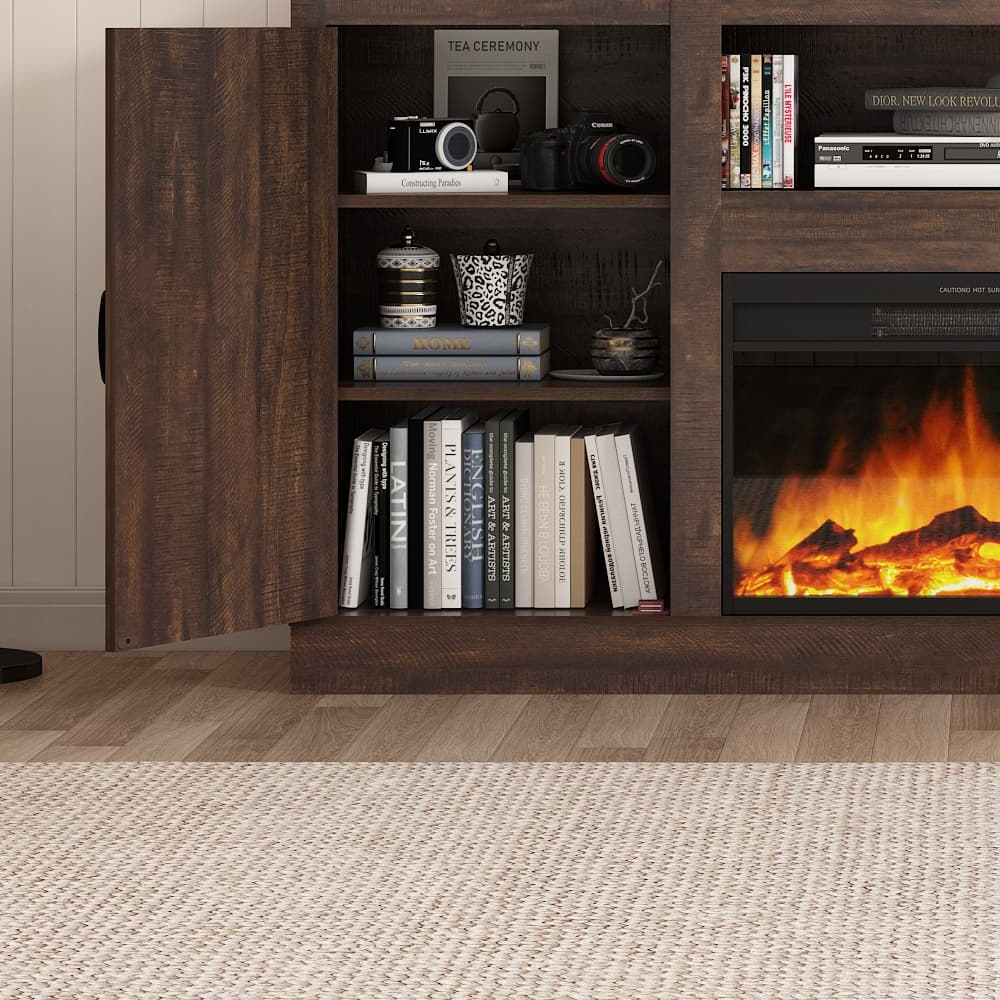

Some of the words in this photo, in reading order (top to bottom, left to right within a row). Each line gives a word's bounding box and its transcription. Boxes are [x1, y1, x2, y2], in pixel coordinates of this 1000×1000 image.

[448, 40, 470, 52] TEA
[473, 40, 540, 52] CEREMONY
[903, 96, 925, 106] NEW
[928, 96, 956, 107] LOOK
[401, 178, 436, 190] Constructing
[413, 336, 472, 350] HOME
[427, 423, 437, 460] Moving
[360, 443, 369, 466] Designing
[445, 444, 456, 502] PLANTS
[429, 462, 438, 505] Norman
[445, 507, 456, 517] &
[472, 448, 483, 562] ENGLISH
[429, 508, 438, 540] Foster
[488, 522, 495, 531] &
[502, 522, 509, 531] &
[429, 543, 436, 556] on
[445, 524, 456, 572] TREES
[429, 559, 438, 575] Art
